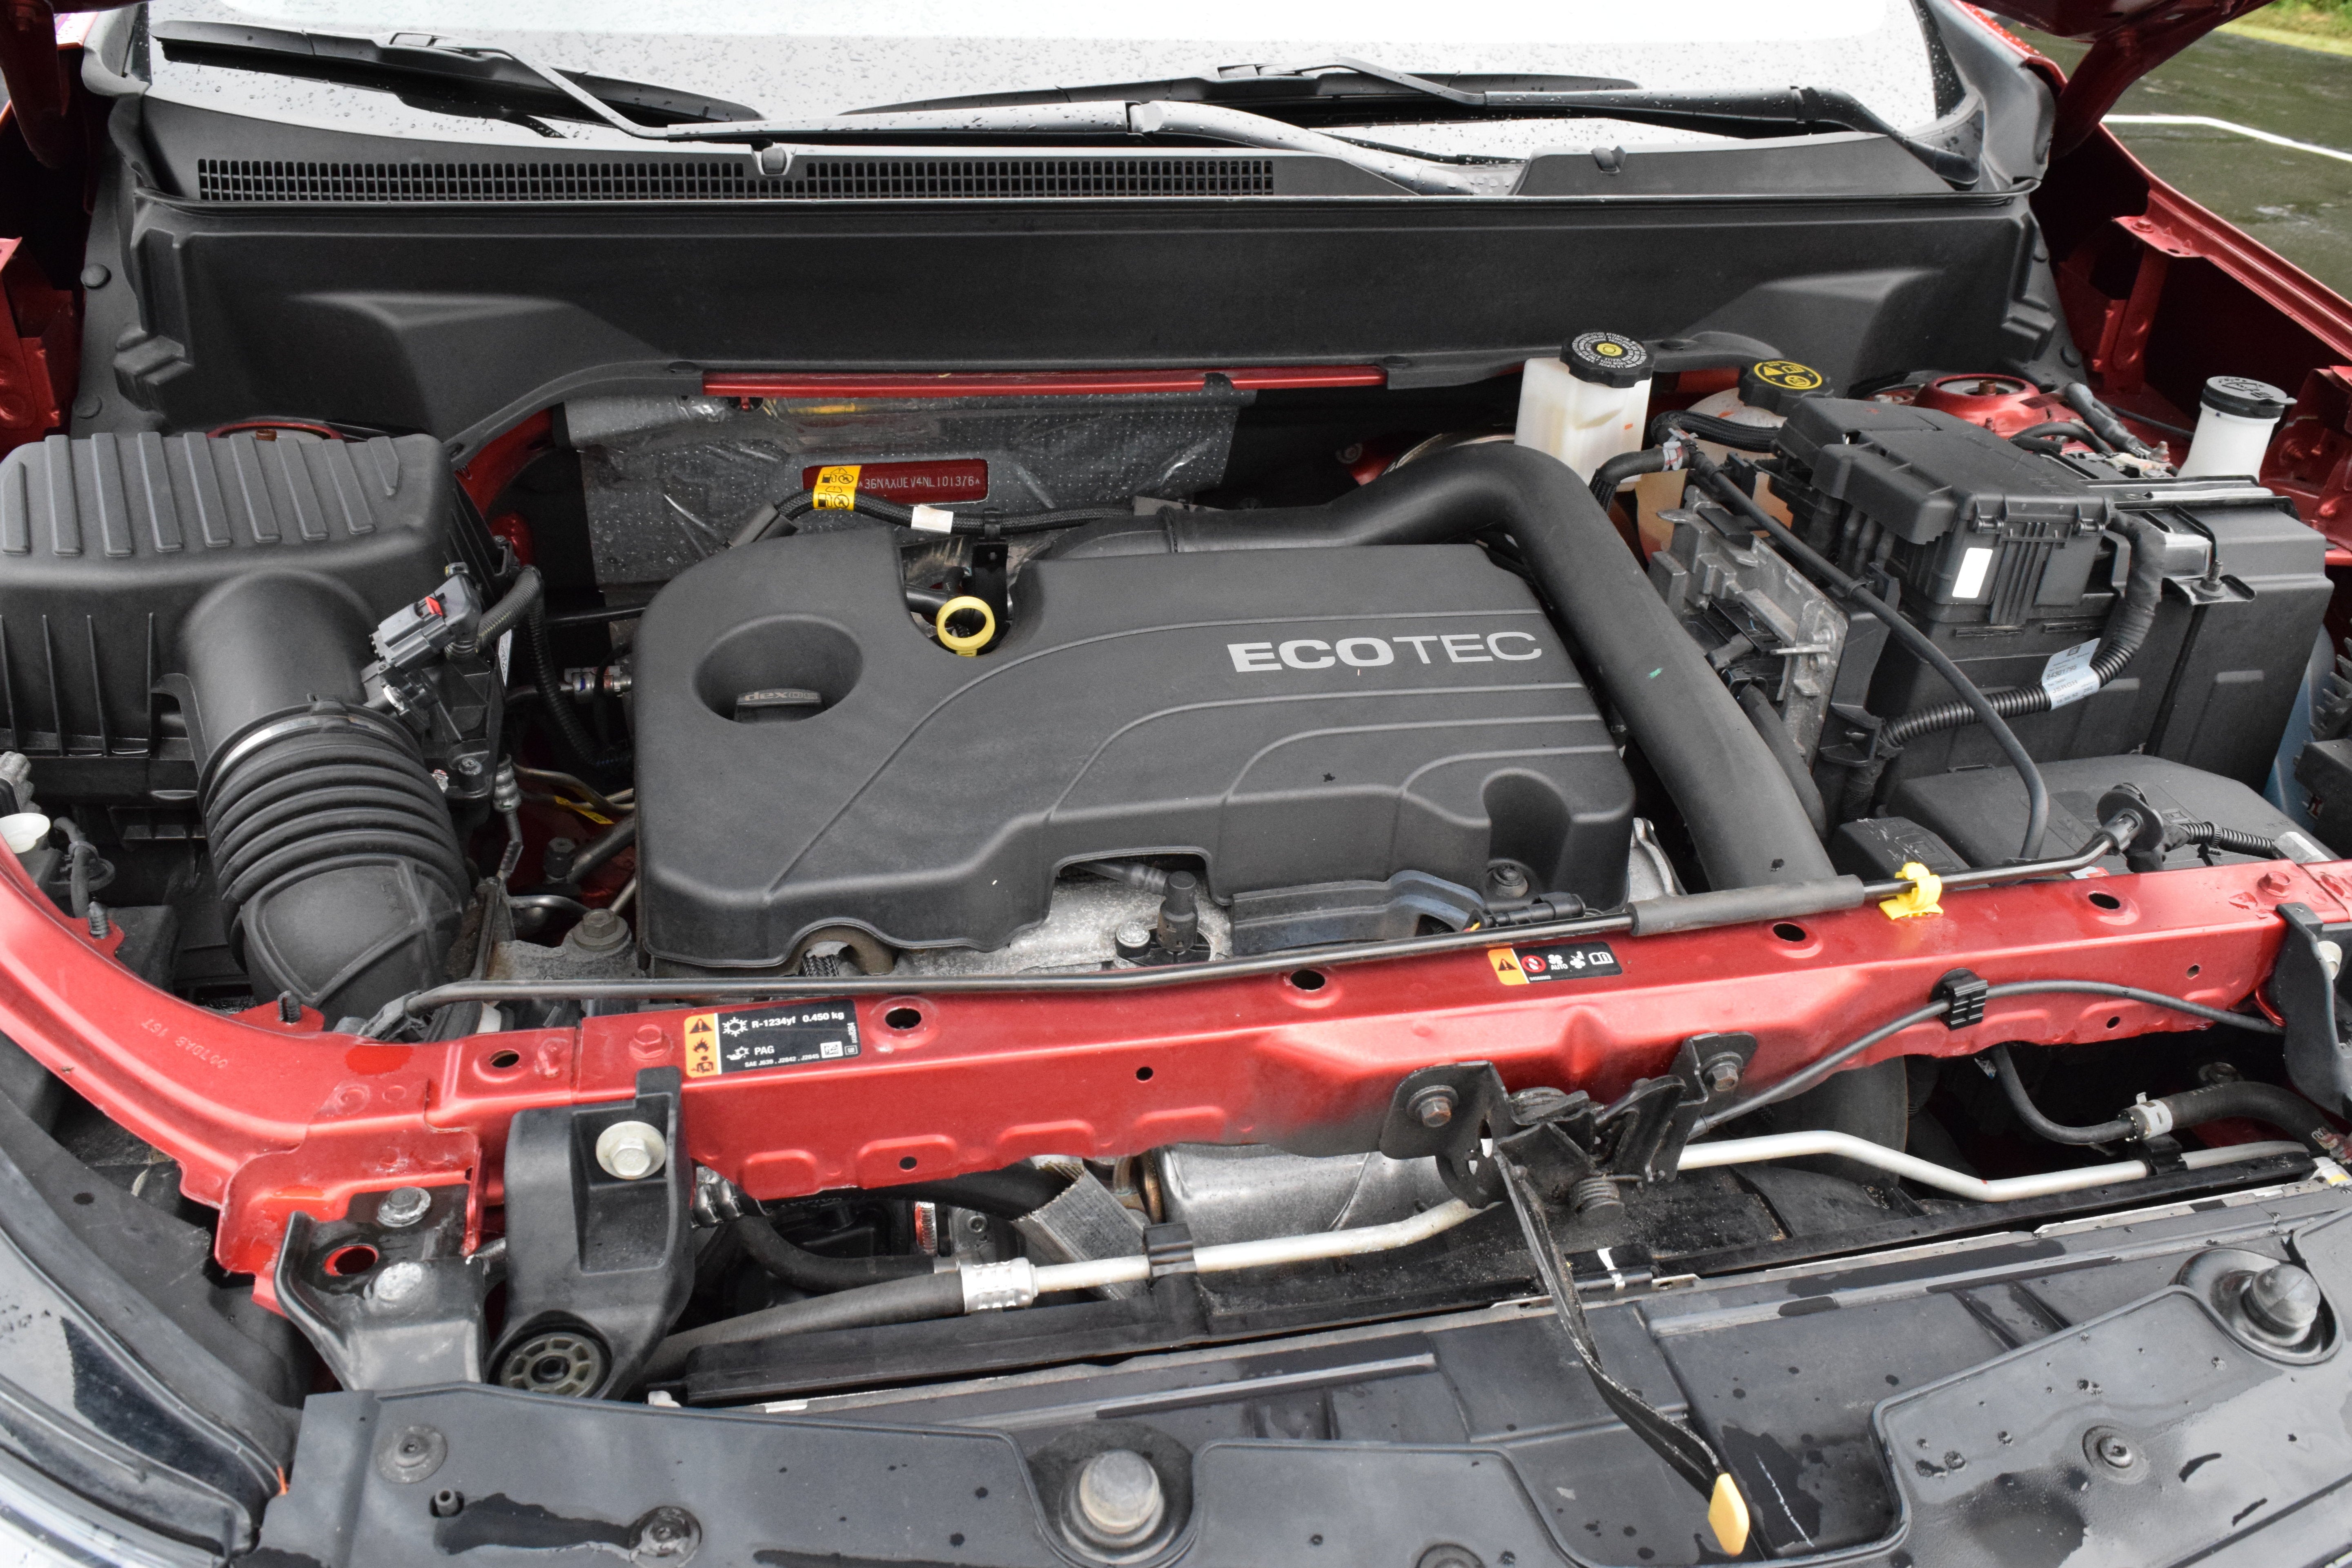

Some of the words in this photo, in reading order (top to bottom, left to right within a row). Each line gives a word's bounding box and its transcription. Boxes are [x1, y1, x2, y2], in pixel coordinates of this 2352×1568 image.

[1227, 632, 1542, 673] ECOTEC
[744, 692, 818, 702] dexos
[752, 1016, 796, 1028] R-1234yf
[802, 1013, 829, 1023] 0.450
[831, 1011, 844, 1020] kg
[754, 1045, 775, 1055] PAG
